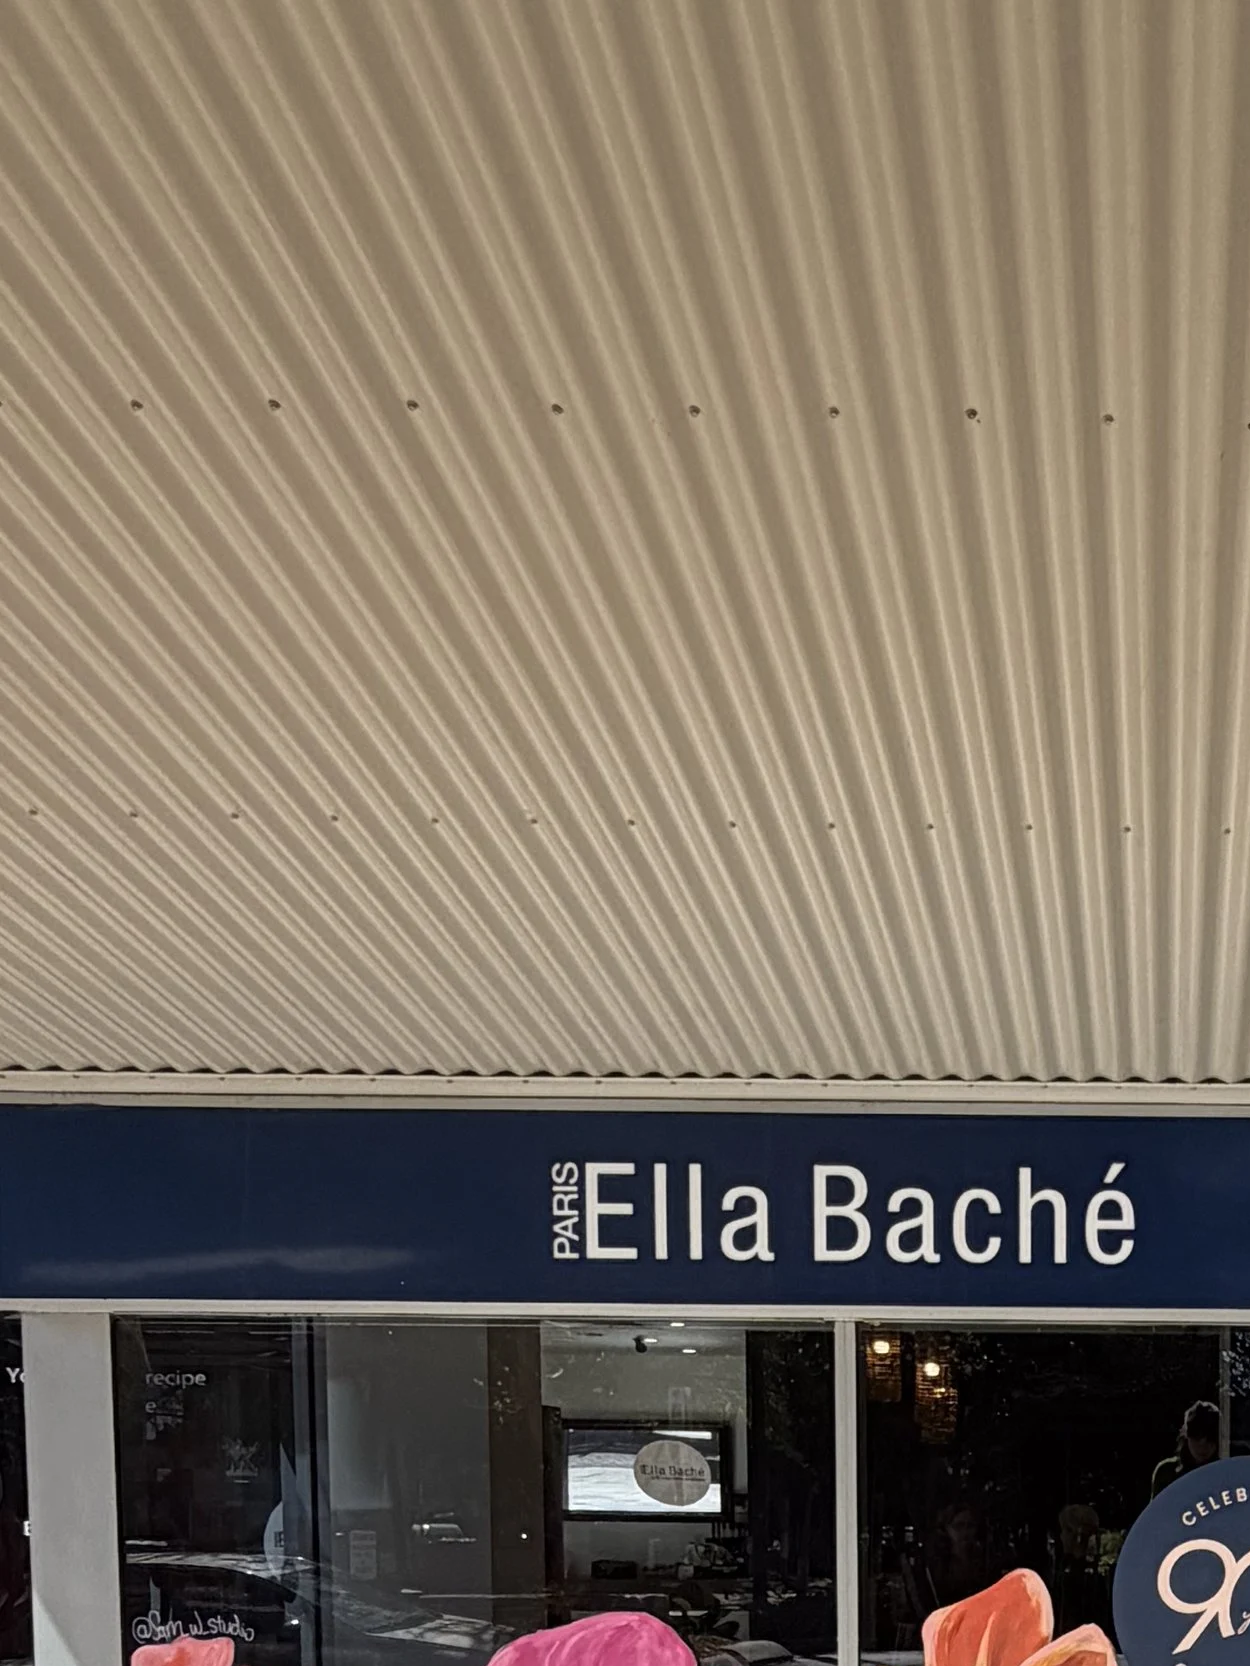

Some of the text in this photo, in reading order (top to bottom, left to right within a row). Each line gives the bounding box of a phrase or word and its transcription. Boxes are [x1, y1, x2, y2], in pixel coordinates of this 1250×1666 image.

[553, 1162, 579, 1260] PARIS
[585, 1162, 1136, 1265] Ella Baché
[145, 1370, 207, 1388] recipe
